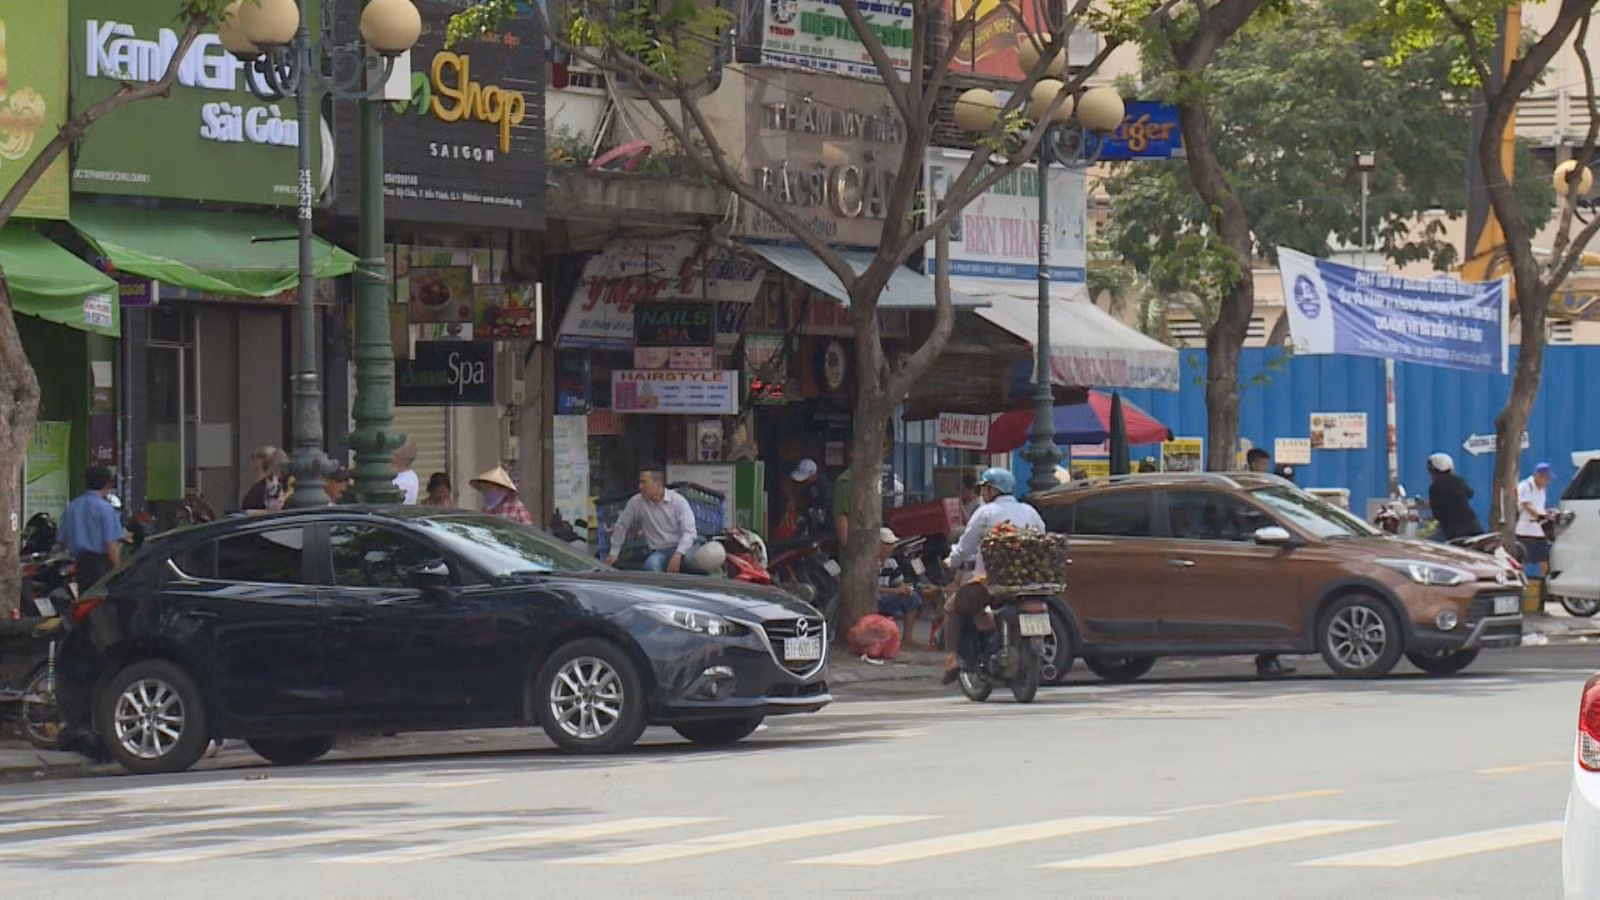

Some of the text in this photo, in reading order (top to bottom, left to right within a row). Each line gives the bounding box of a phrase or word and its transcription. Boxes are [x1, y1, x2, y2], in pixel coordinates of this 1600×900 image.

[429, 142, 495, 162] SAIGON
[640, 309, 706, 326] NAILS
[447, 351, 485, 396] Spa
[620, 370, 724, 383] HAIRSTYLE
